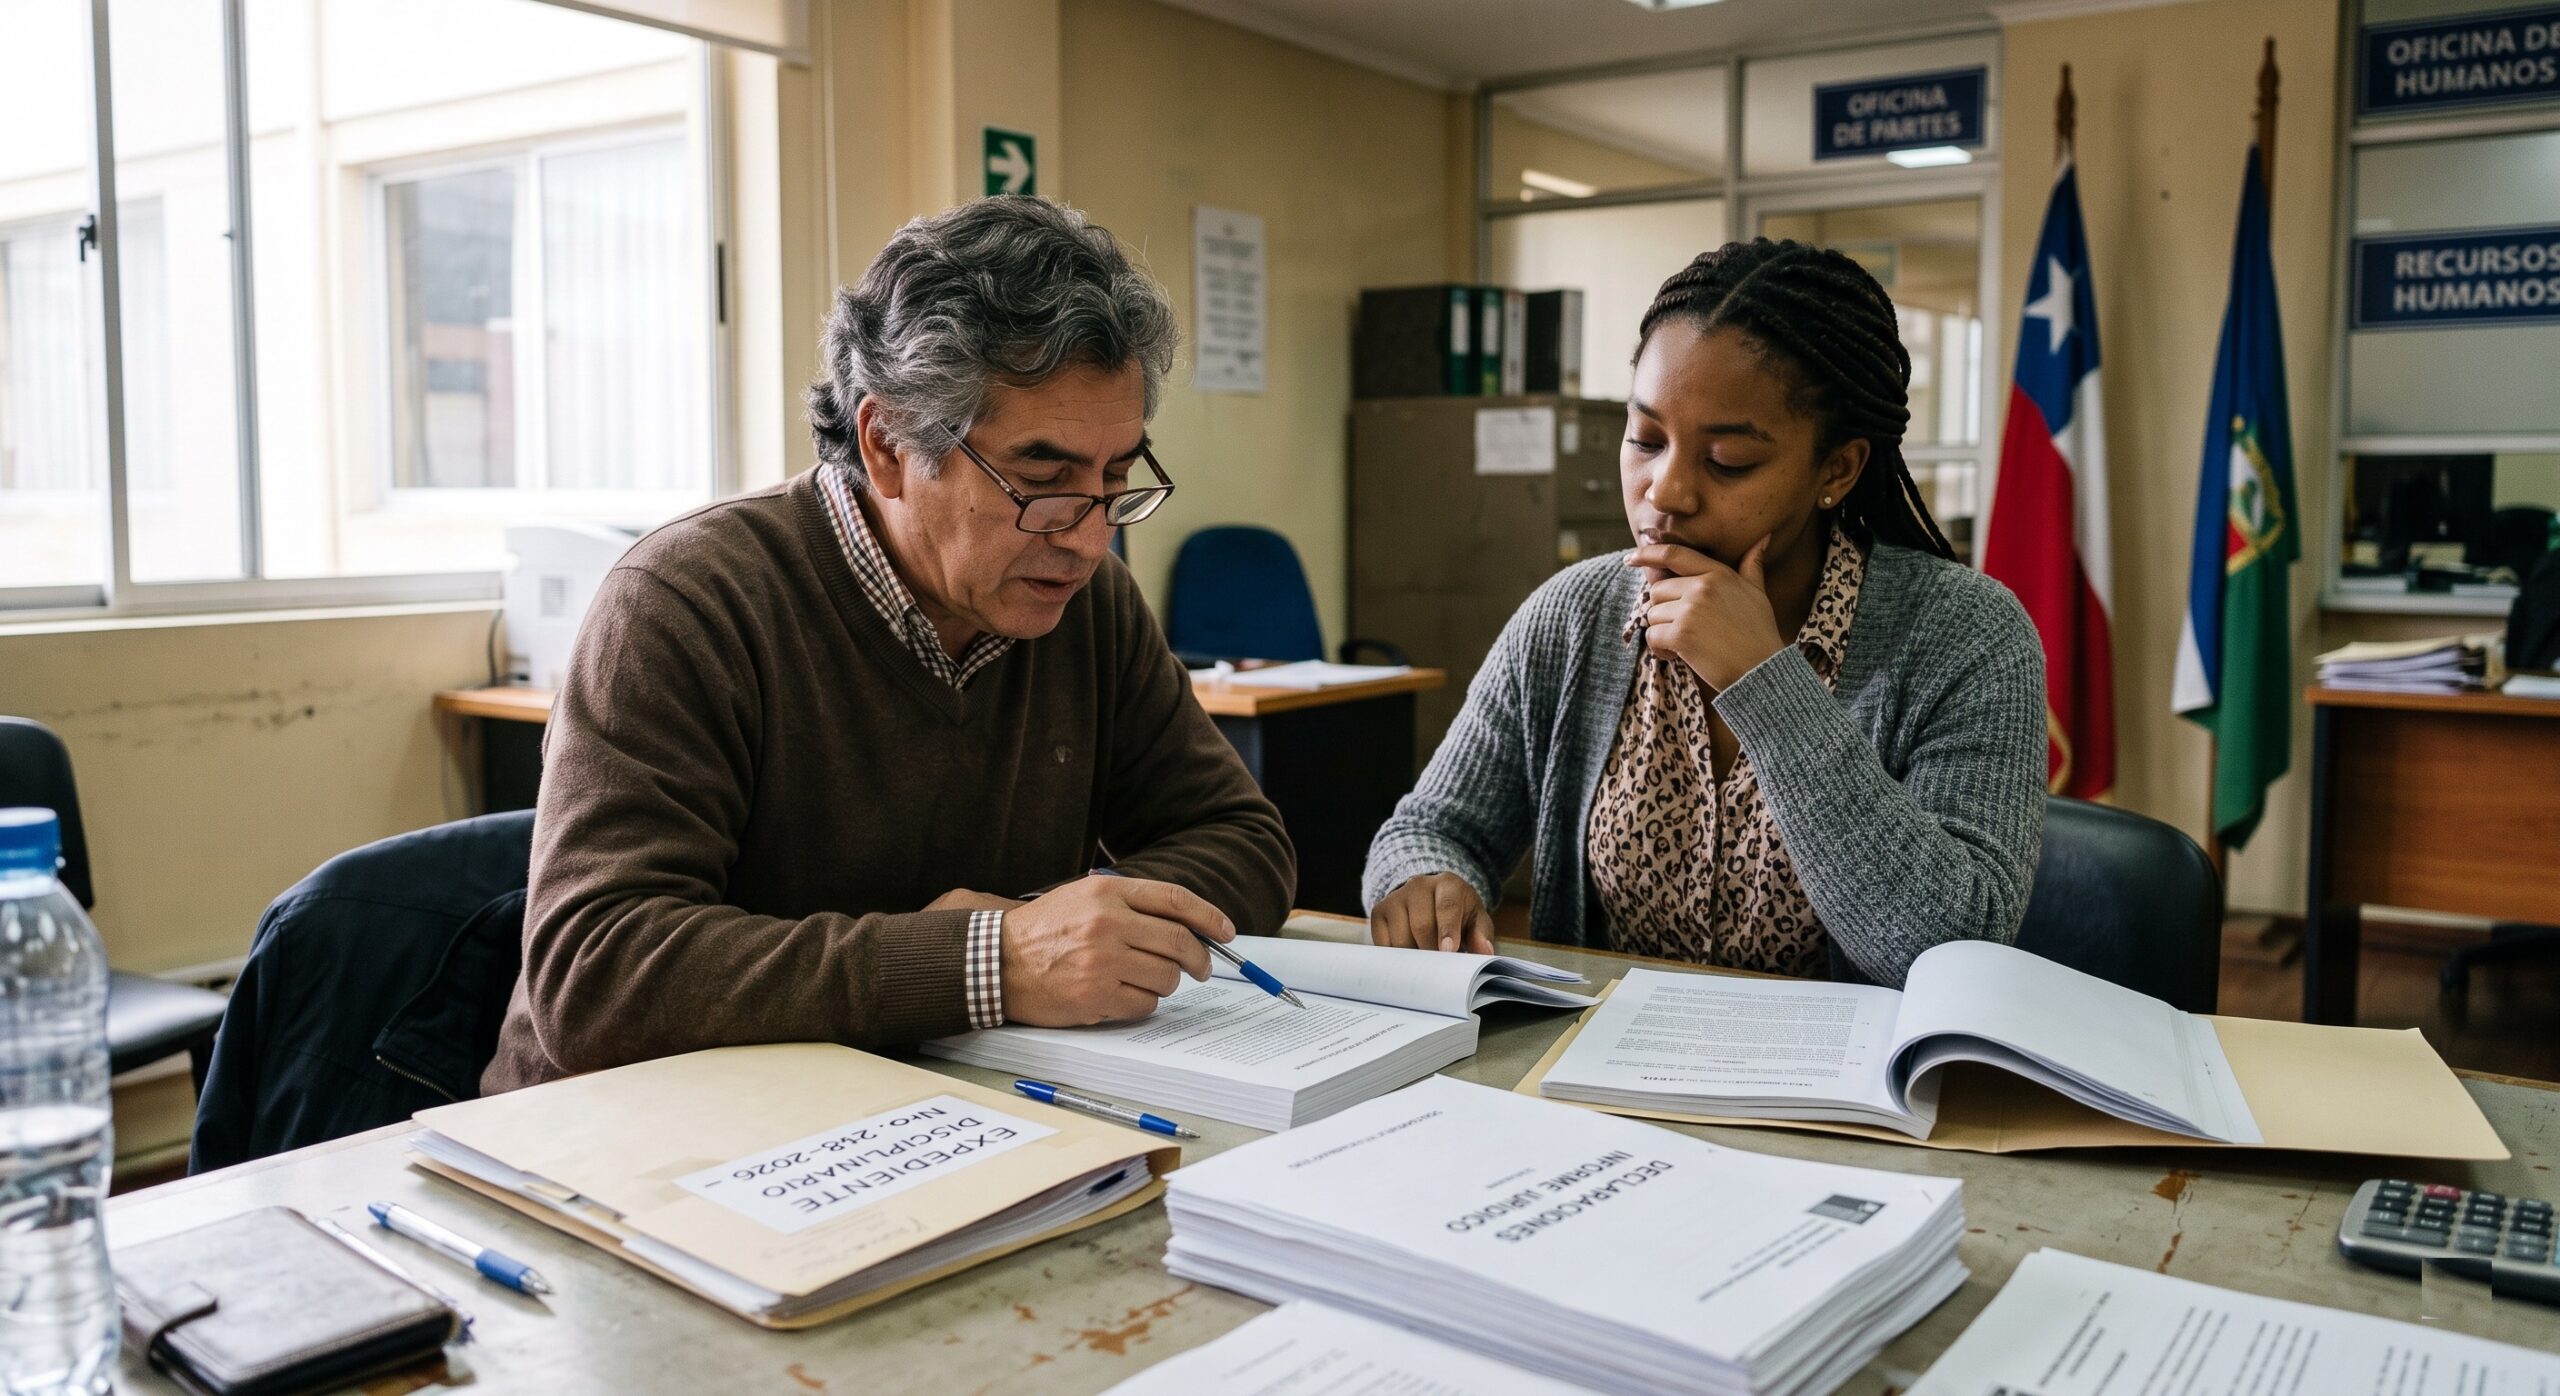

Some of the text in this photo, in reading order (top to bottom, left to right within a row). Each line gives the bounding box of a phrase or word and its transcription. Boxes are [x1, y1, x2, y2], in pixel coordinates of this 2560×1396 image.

[2387, 27, 2516, 66] OFICINA
[2395, 56, 2557, 97] HUMANOS
[1847, 84, 1948, 118] OFICINA
[1833, 110, 1962, 147] DE PARTES
[2394, 243, 2560, 279] RECURSOS
[2393, 277, 2560, 312] HUMANOS
[879, 1106, 948, 1128] Nro.
[762, 1116, 983, 1198] DISCIPLINARIO
[789, 1126, 1019, 1214] EXPEDIENTE
[1537, 1150, 1634, 1192] INFORME
[1495, 1158, 1674, 1242] DECLARACIONES
